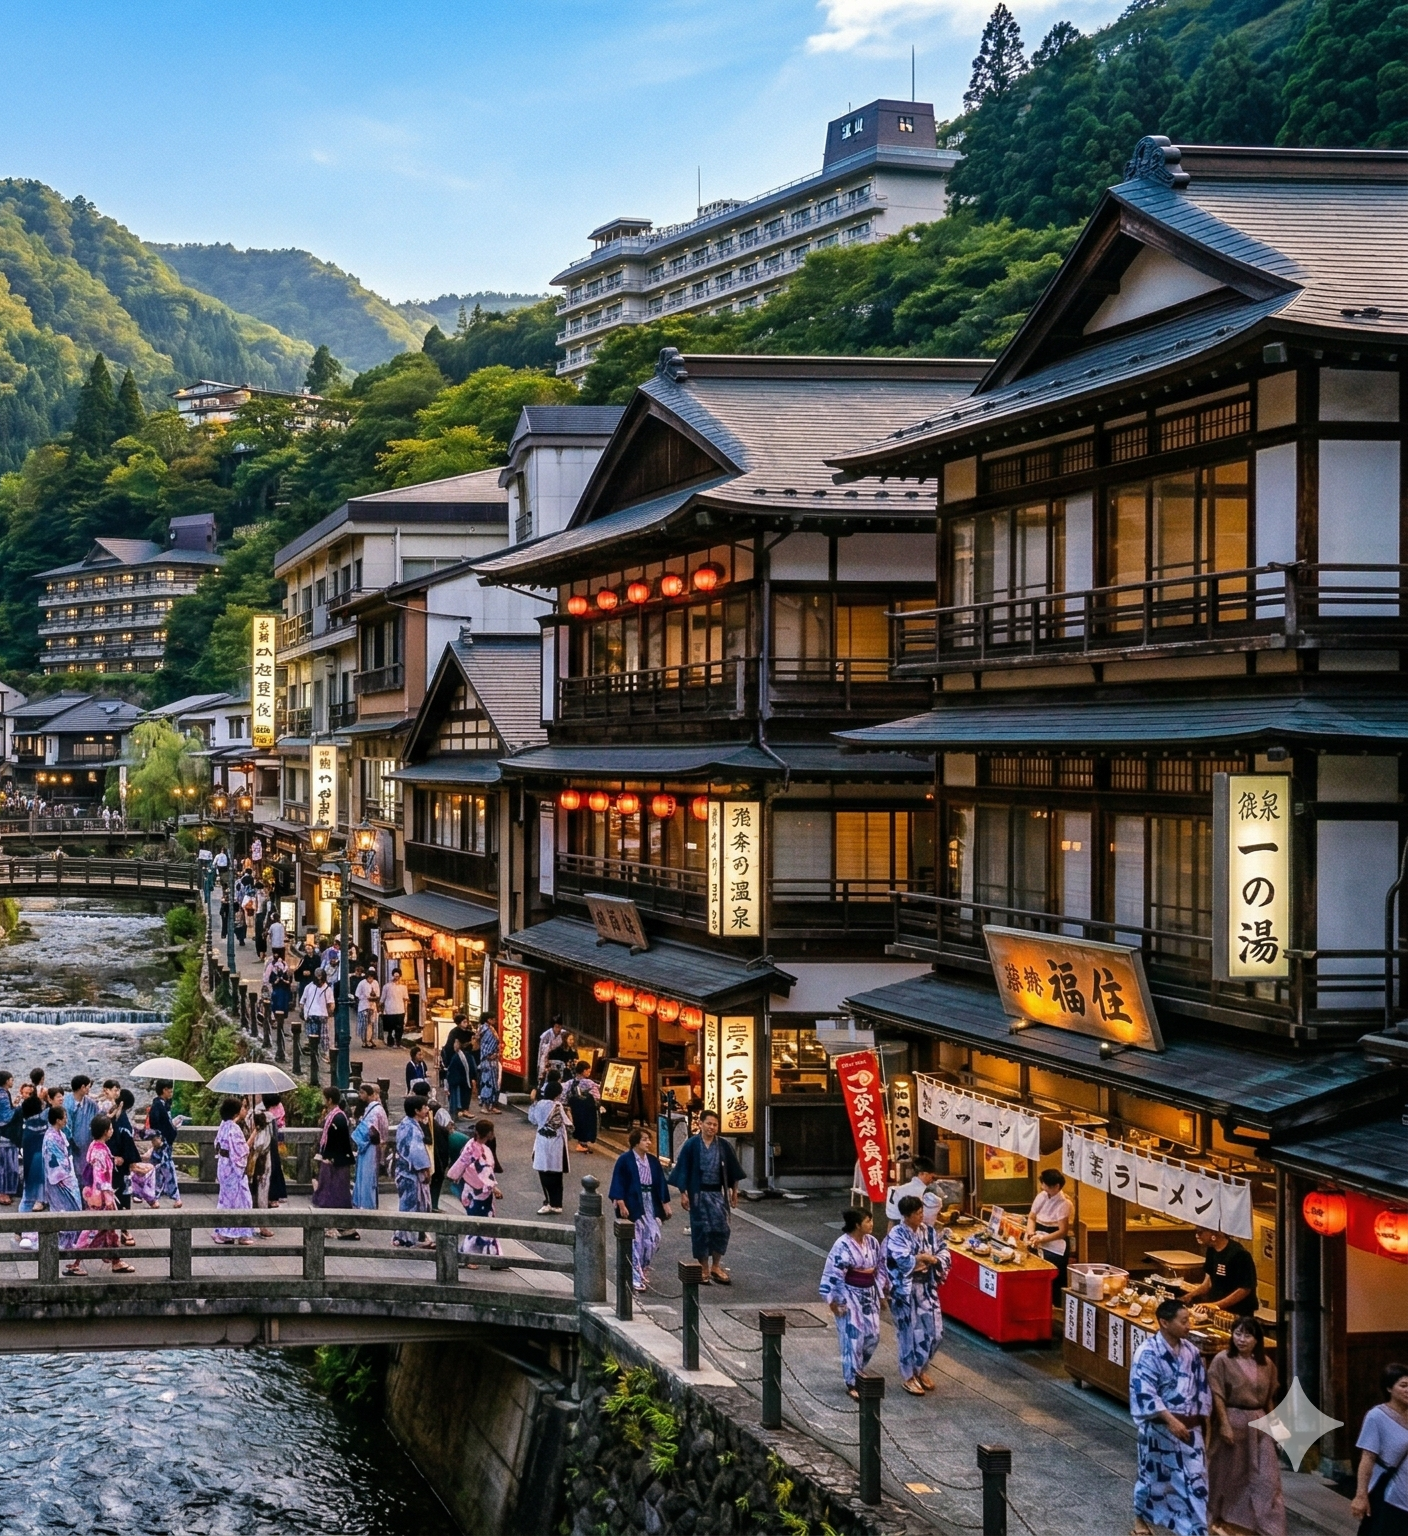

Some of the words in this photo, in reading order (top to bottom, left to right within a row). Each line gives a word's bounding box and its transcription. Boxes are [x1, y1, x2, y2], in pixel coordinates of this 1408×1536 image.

[1237, 842, 1279, 965] 一の湯
[1047, 958, 1133, 1025] 福住
[1114, 1164, 1214, 1215] ラーメン
